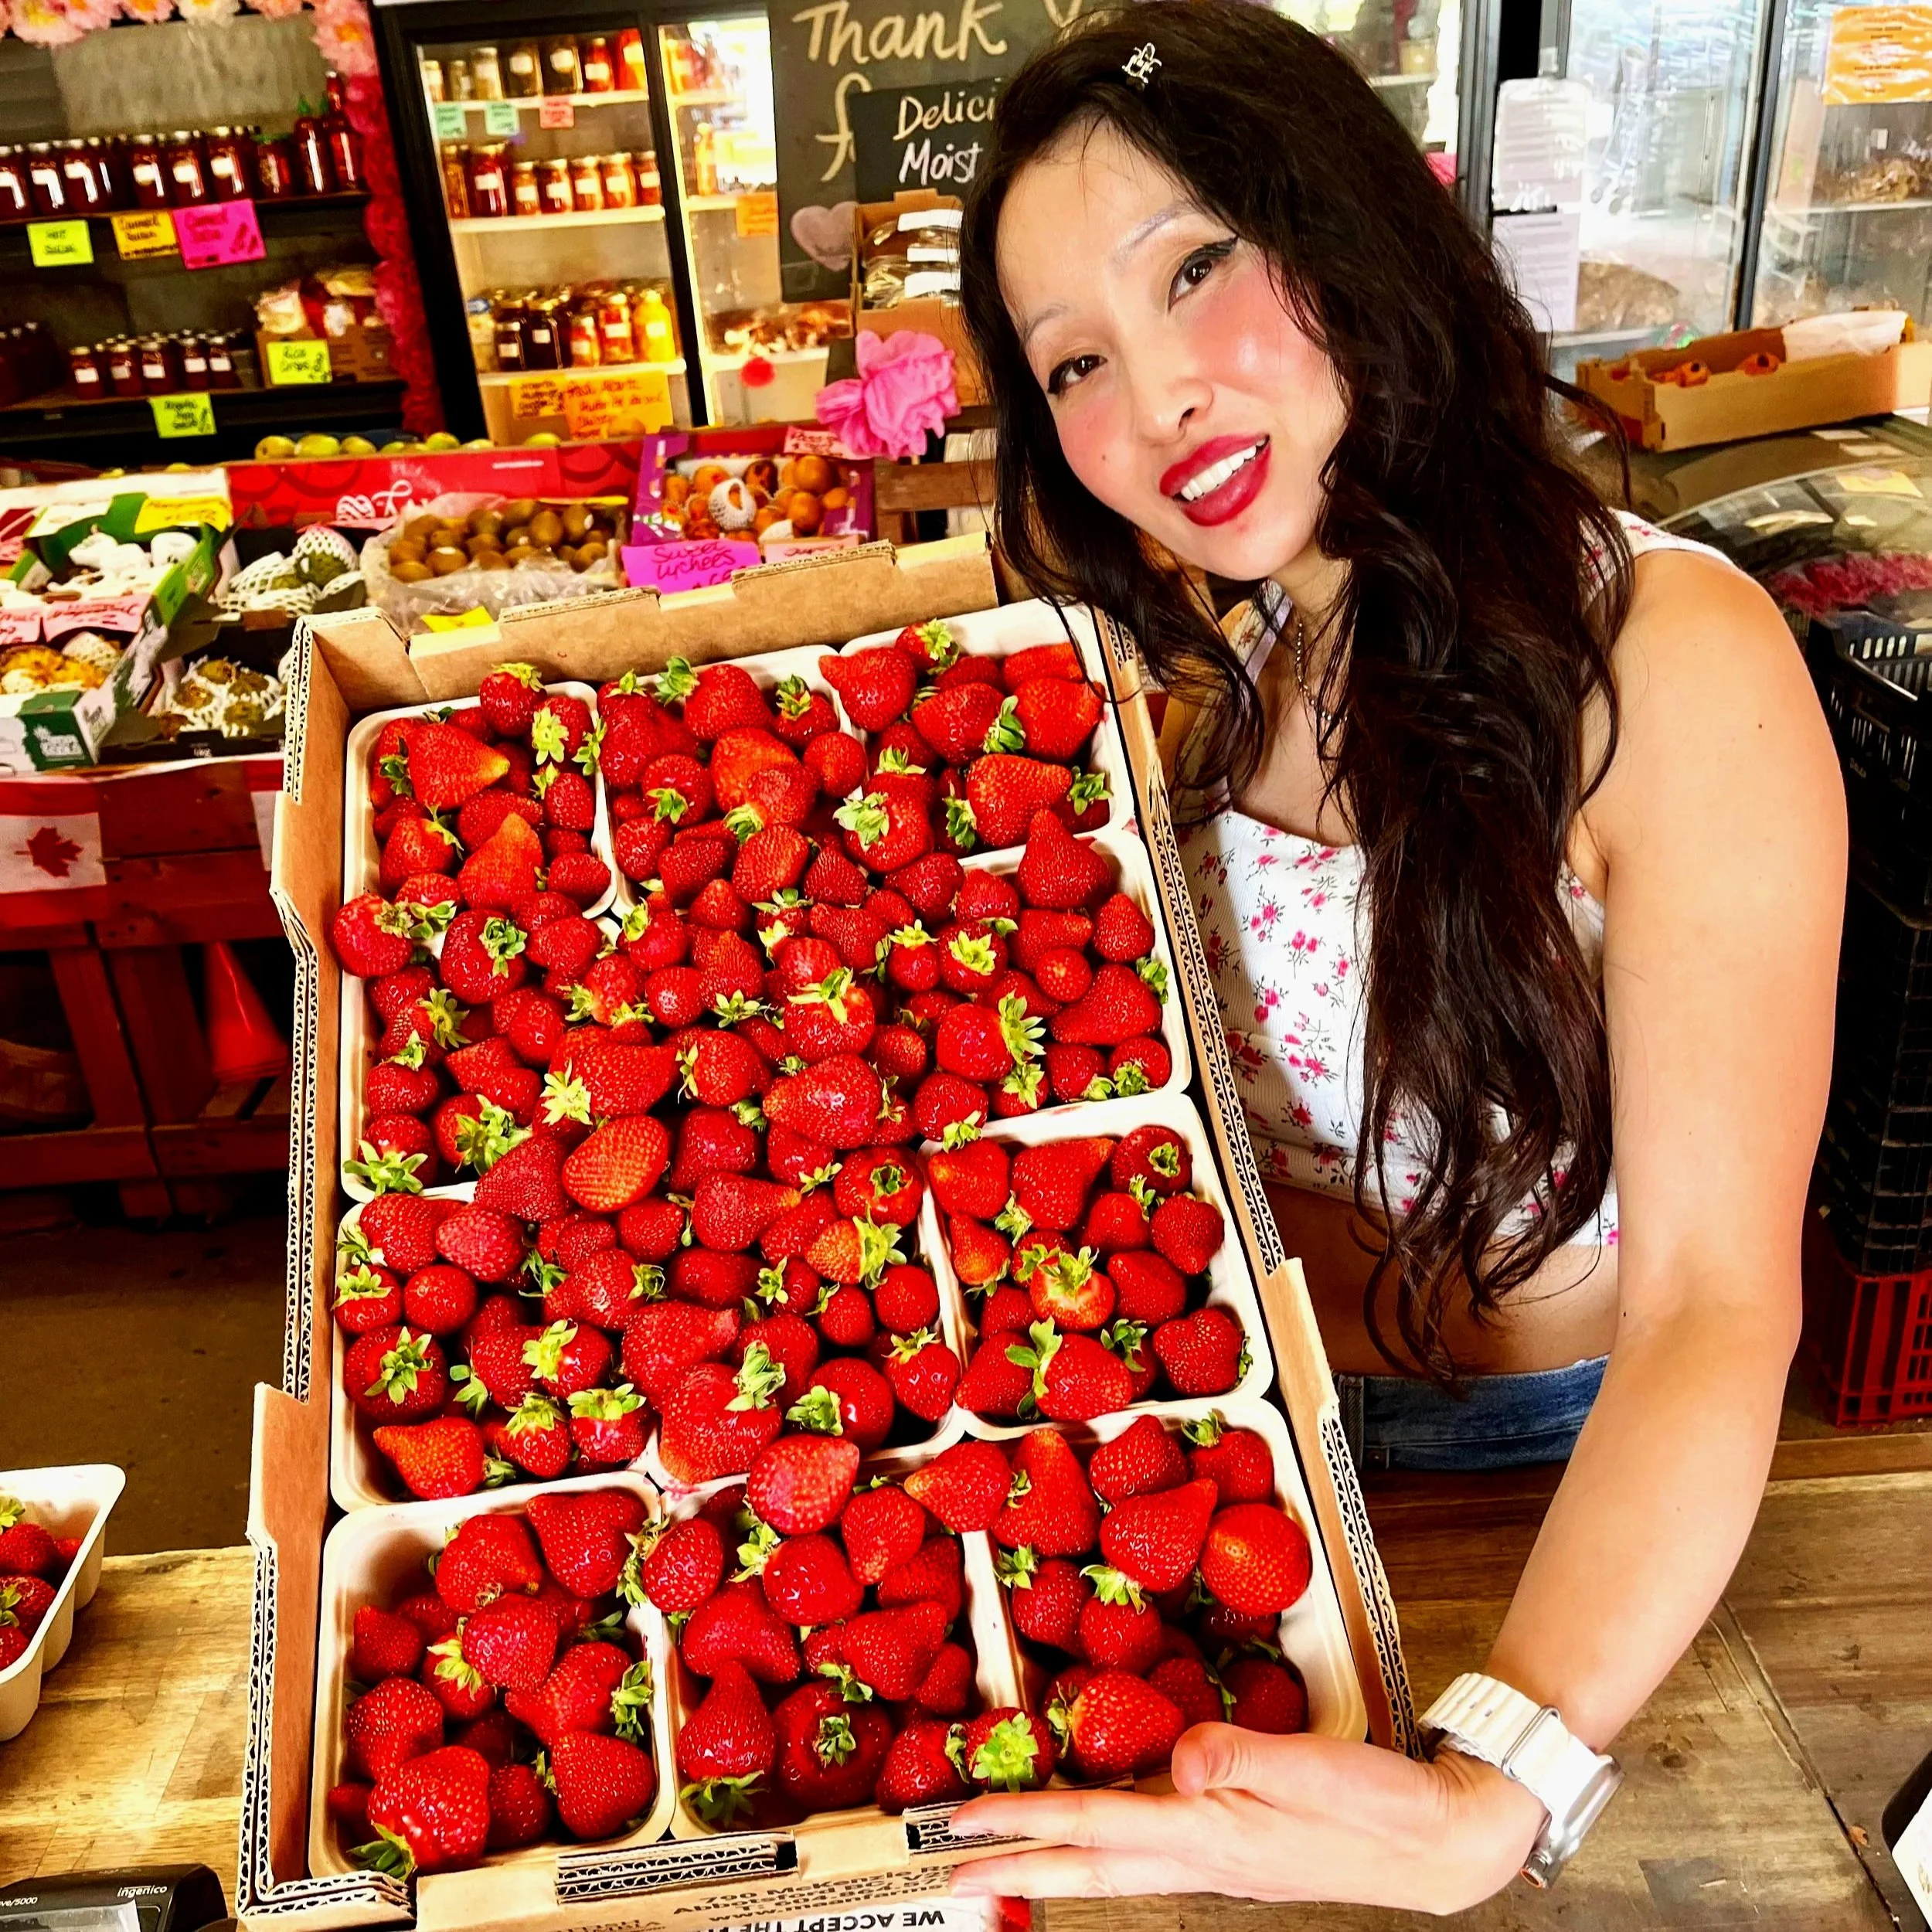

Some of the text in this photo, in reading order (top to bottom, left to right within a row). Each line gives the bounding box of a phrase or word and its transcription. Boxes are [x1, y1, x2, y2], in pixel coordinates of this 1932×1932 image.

[792, 0, 1007, 66] Thank
[893, 87, 998, 141] Delici
[899, 138, 983, 185] Moist
[651, 542, 726, 563] Sweet
[117, 1885, 168, 1898] ingenico
[699, 1892, 757, 1903] 790
[767, 1871, 912, 1896] McKenzie
[0, 1896, 39, 1907] ve/5000
[673, 1887, 835, 1914] Abbotsford
[796, 1913, 895, 1932] ACCEPT
[902, 1910, 945, 1927] WE
